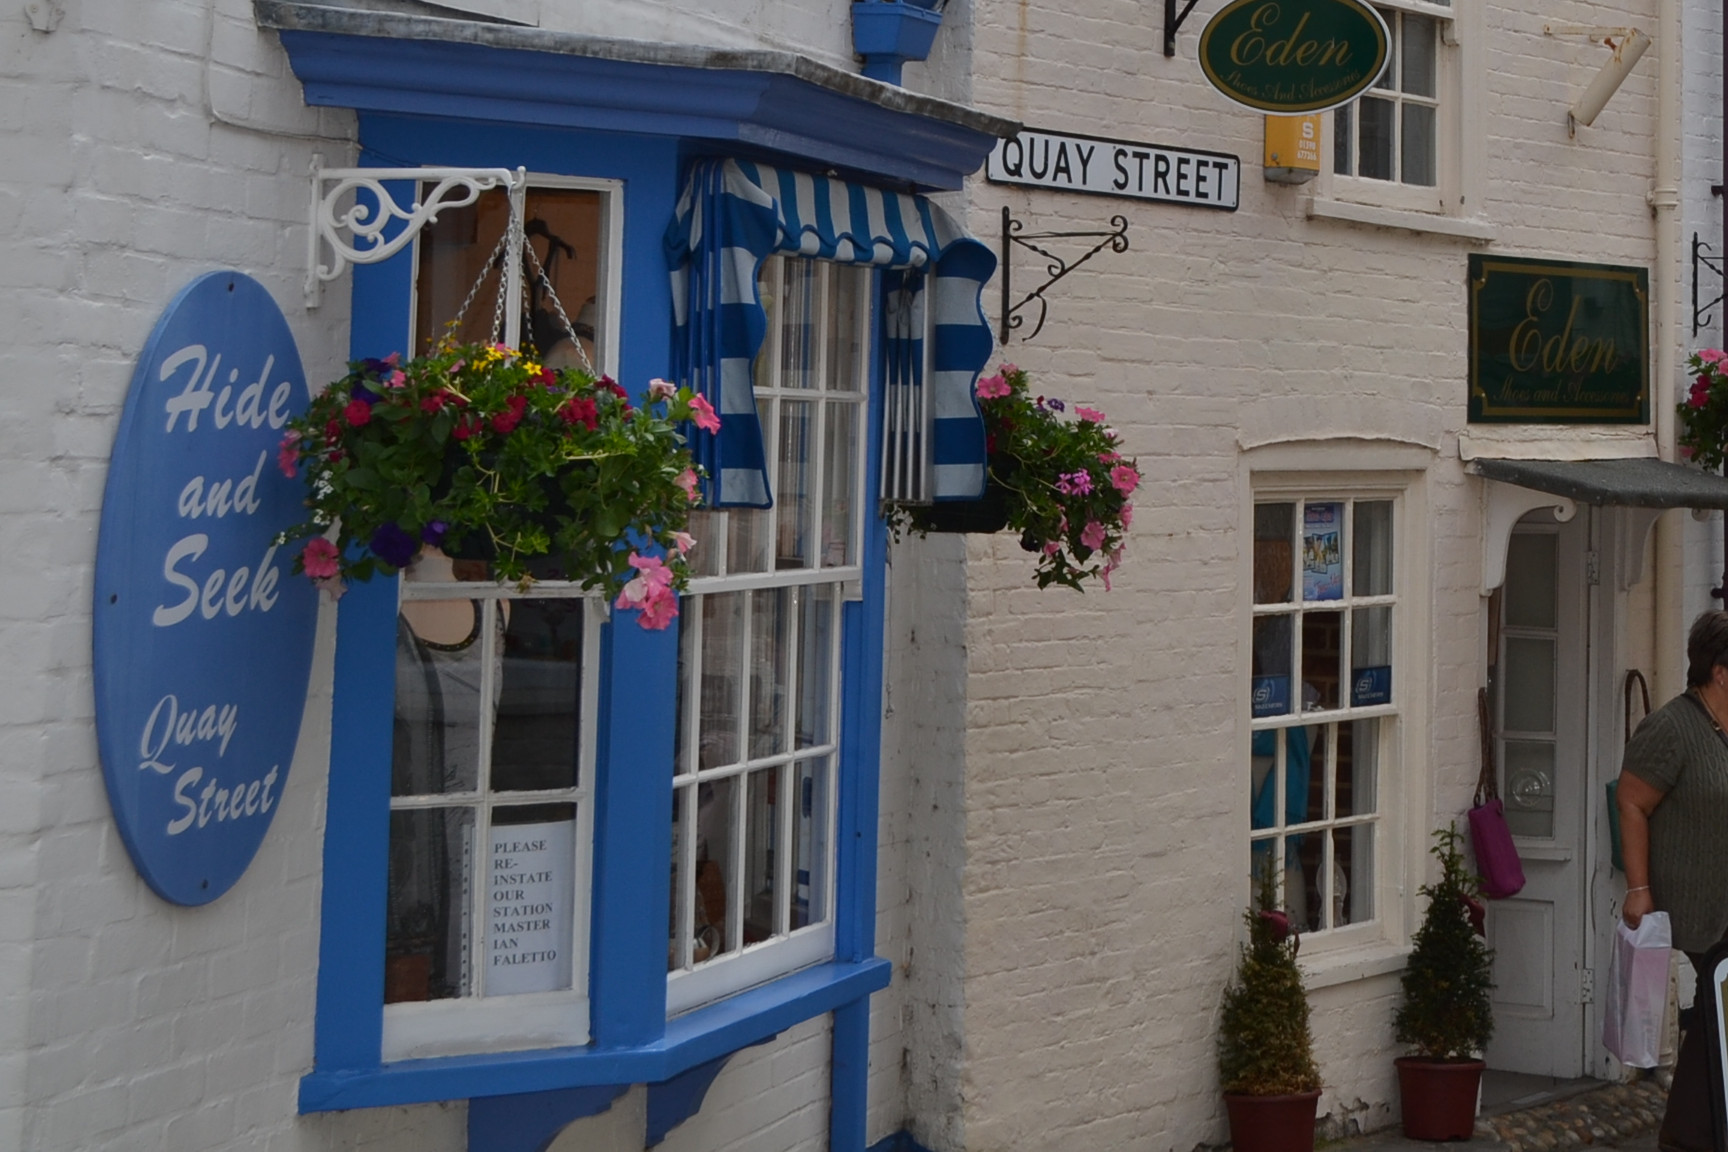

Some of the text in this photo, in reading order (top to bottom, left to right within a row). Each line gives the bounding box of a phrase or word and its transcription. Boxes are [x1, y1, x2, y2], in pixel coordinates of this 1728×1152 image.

[1229, 1, 1353, 67] Eden
[1002, 137, 1229, 201] QUAY STREET
[1508, 278, 1618, 375] Eden
[160, 344, 291, 434] Hide
[178, 449, 268, 520] and
[152, 533, 281, 628] Seek
[139, 694, 239, 775] Quay
[167, 764, 281, 837] Street
[493, 840, 548, 854] PLEASE
[493, 858, 519, 870] RE-
[493, 871, 553, 886] INSTATE
[493, 890, 526, 902] OUR
[493, 903, 554, 918] STATION
[493, 919, 551, 934] MASTER
[493, 937, 519, 950] IAN
[493, 950, 557, 966] FALETTO
